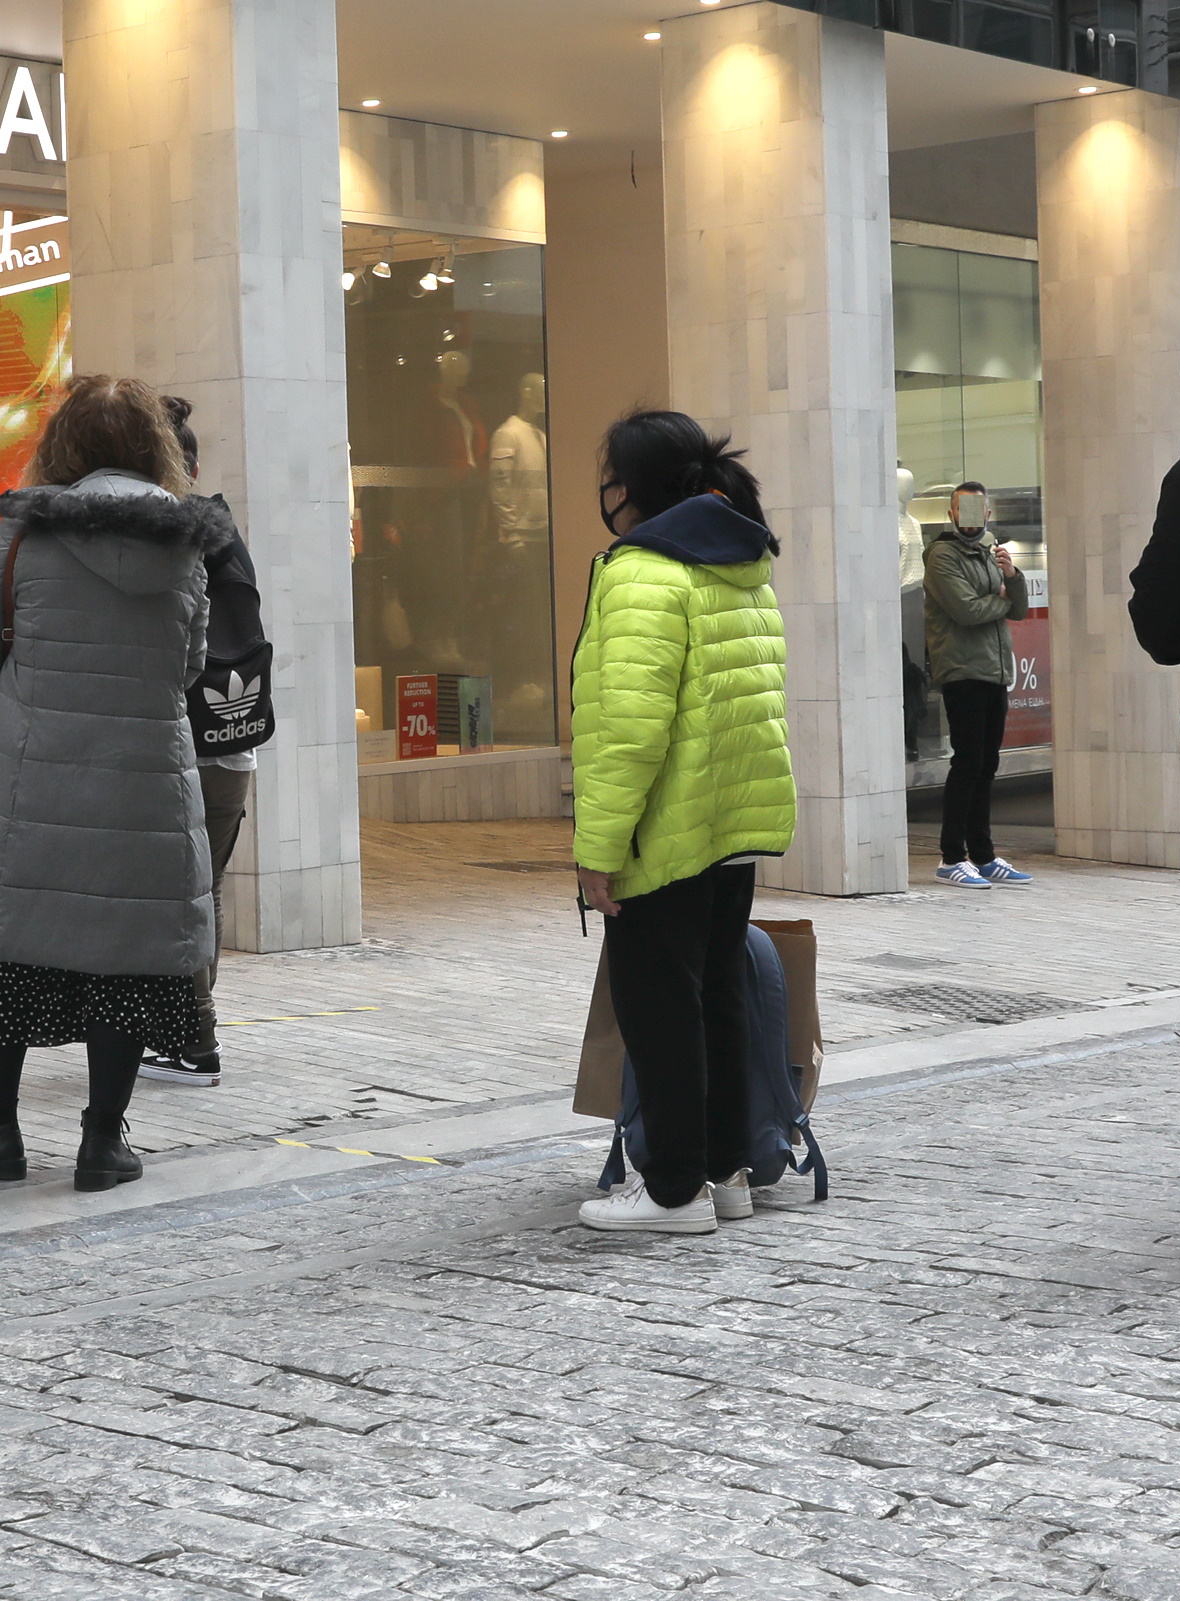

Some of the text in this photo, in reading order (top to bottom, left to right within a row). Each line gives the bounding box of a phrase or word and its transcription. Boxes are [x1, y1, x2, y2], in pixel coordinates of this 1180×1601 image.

[0, 66, 67, 161] A
[403, 689, 432, 697] REDUCTION
[204, 718, 266, 743] adidas
[402, 714, 436, 737] -70%
